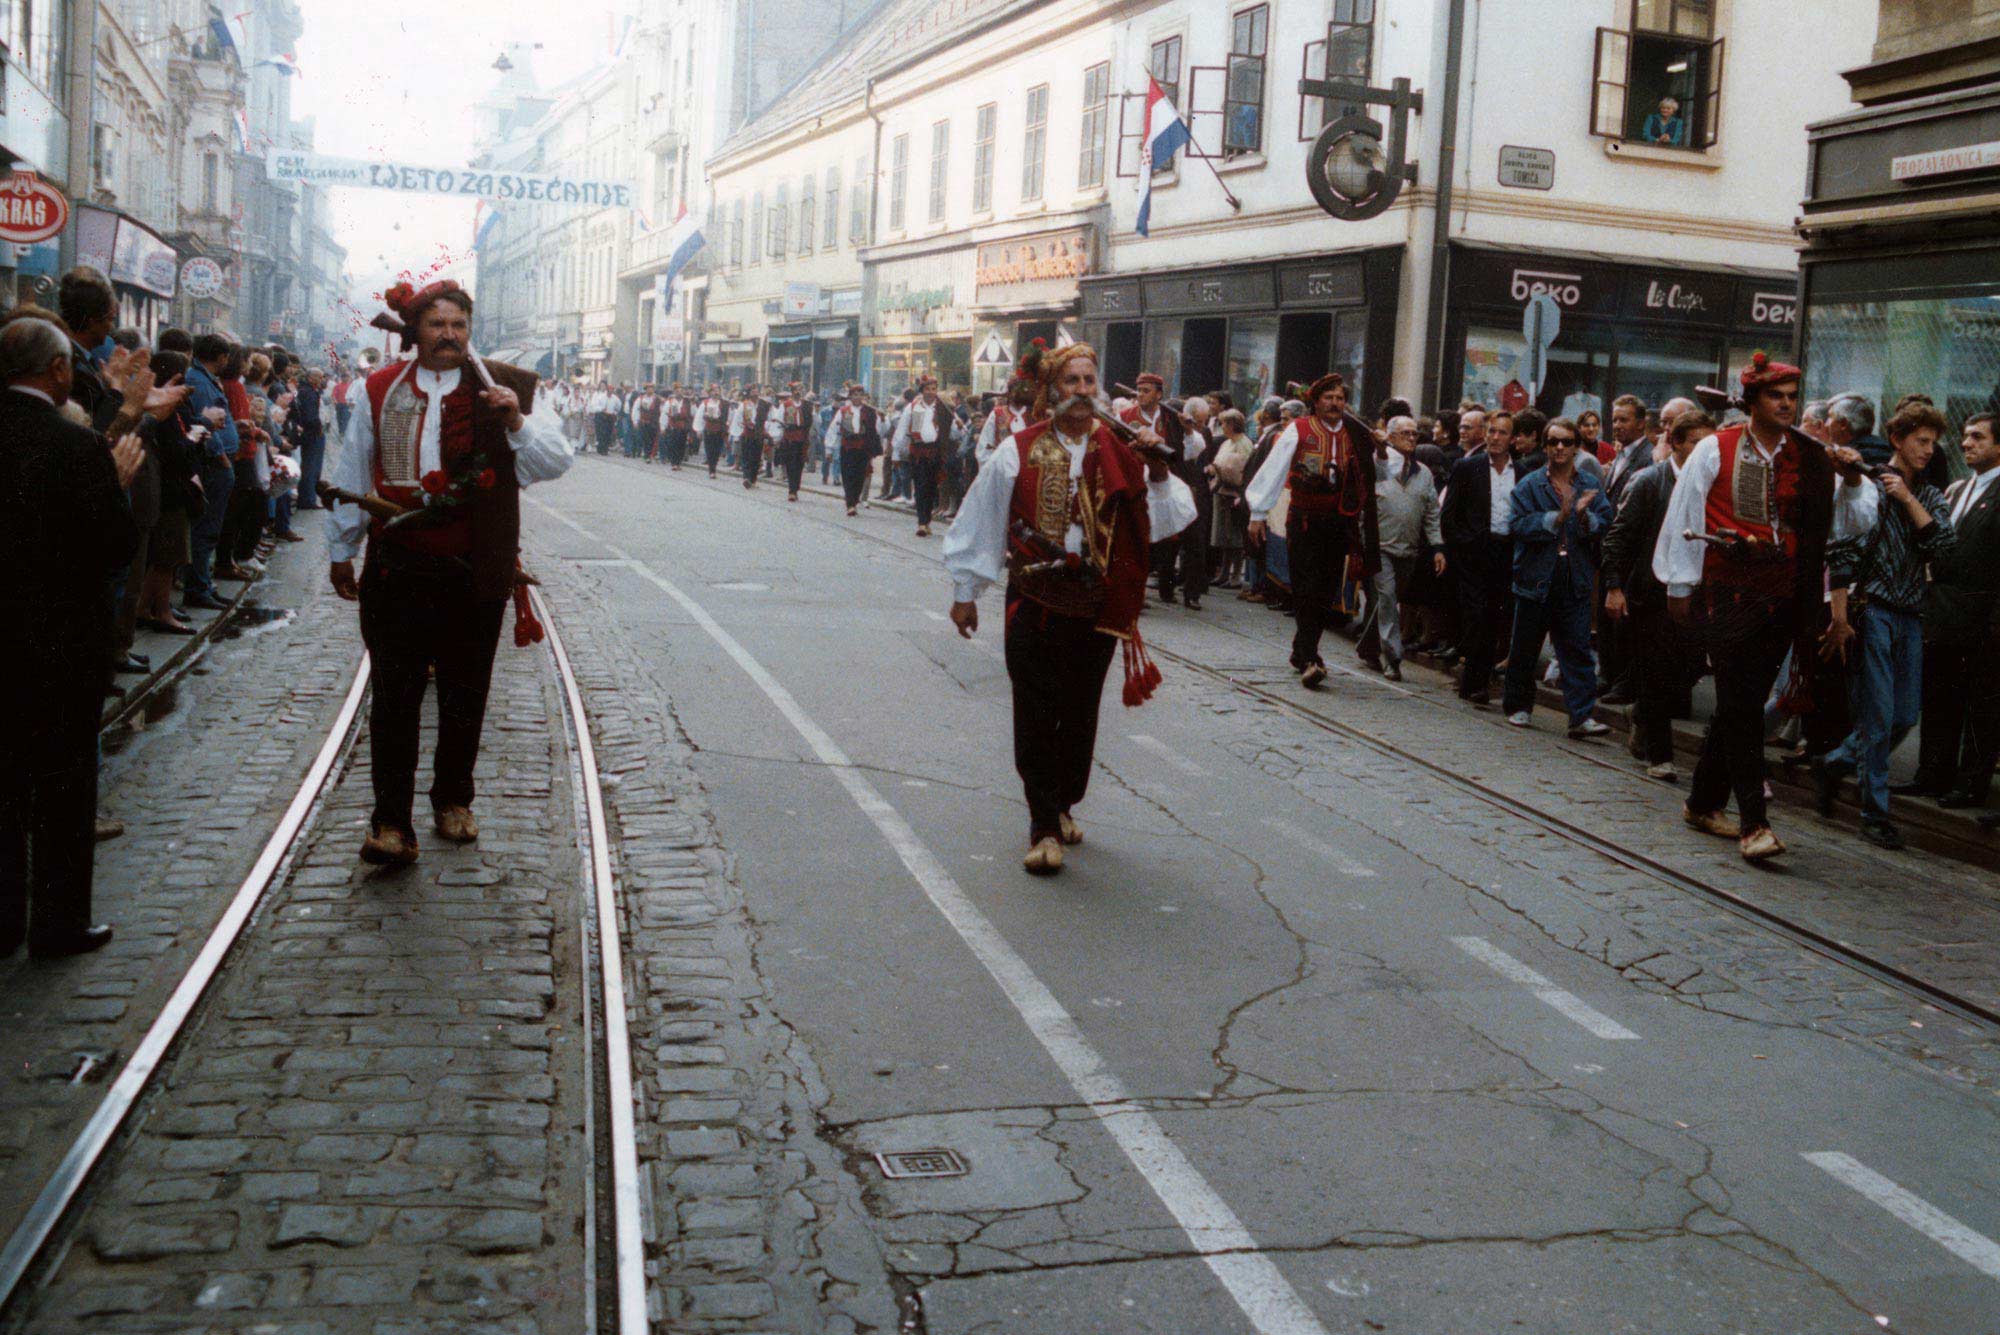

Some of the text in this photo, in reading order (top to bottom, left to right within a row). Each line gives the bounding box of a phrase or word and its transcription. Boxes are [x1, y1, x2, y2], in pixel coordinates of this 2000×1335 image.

[1894, 150, 1982, 178] PRODAVAONICA
[368, 164, 631, 207] LJETO ZA SJEĆANJE
[0, 196, 46, 226] KRAŠ
[1511, 269, 1582, 305] beko
[1752, 292, 1797, 323] bek
